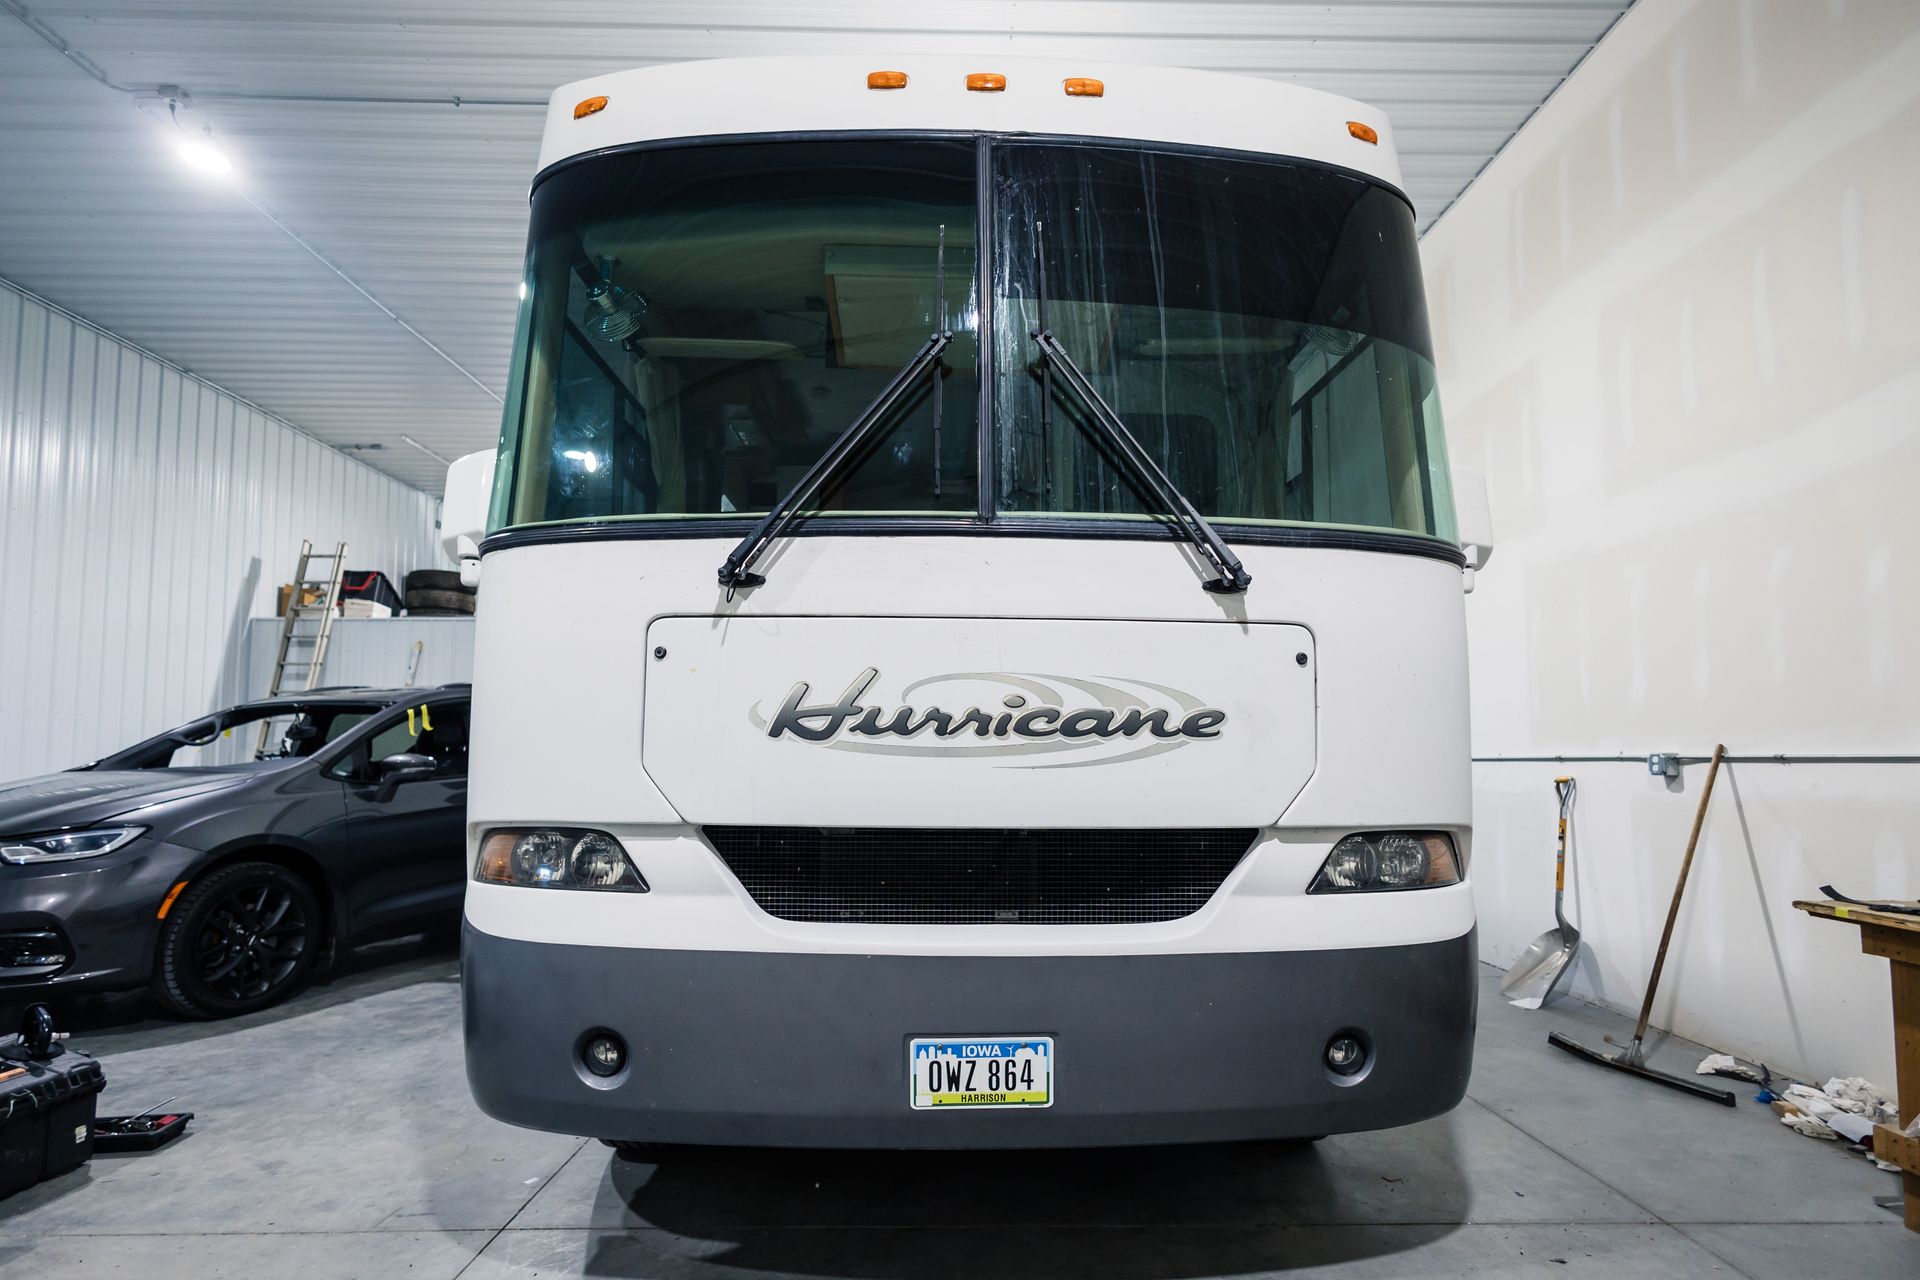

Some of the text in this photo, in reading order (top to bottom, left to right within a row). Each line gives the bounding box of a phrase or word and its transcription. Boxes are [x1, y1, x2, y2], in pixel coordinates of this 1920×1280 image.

[767, 667, 1227, 741] Hurricane
[962, 1045, 1001, 1057] IOWA
[928, 1059, 1034, 1093] OWZ 864
[961, 1093, 1006, 1103] HARRISON
